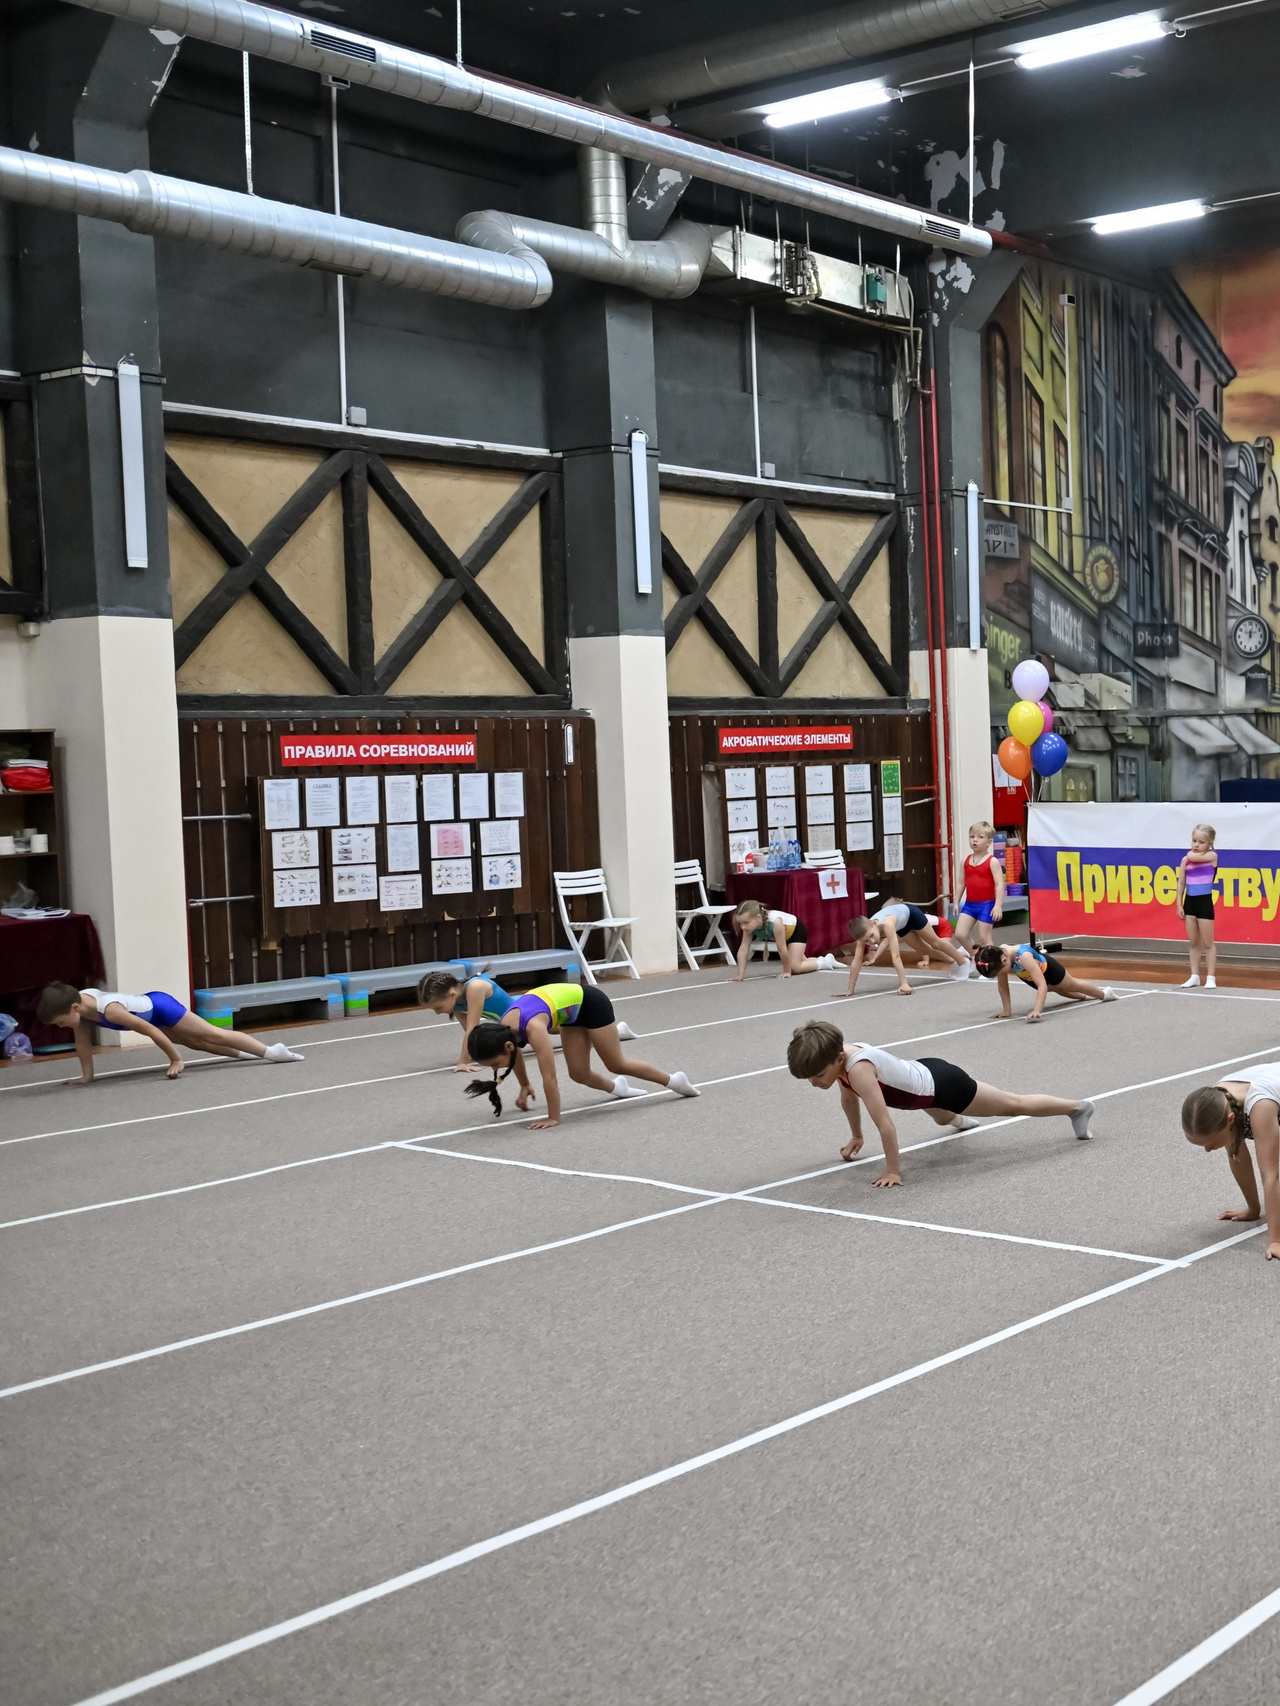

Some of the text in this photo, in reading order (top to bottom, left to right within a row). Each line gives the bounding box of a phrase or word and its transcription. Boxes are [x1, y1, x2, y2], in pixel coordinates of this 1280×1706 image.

[722, 734, 851, 747] АКРОБАТИЧЕСКИЕ ЭЛЕМЕНТЫ
[284, 742, 475, 759] ПРАВИЛА СОРЕВНОВАНИЙ
